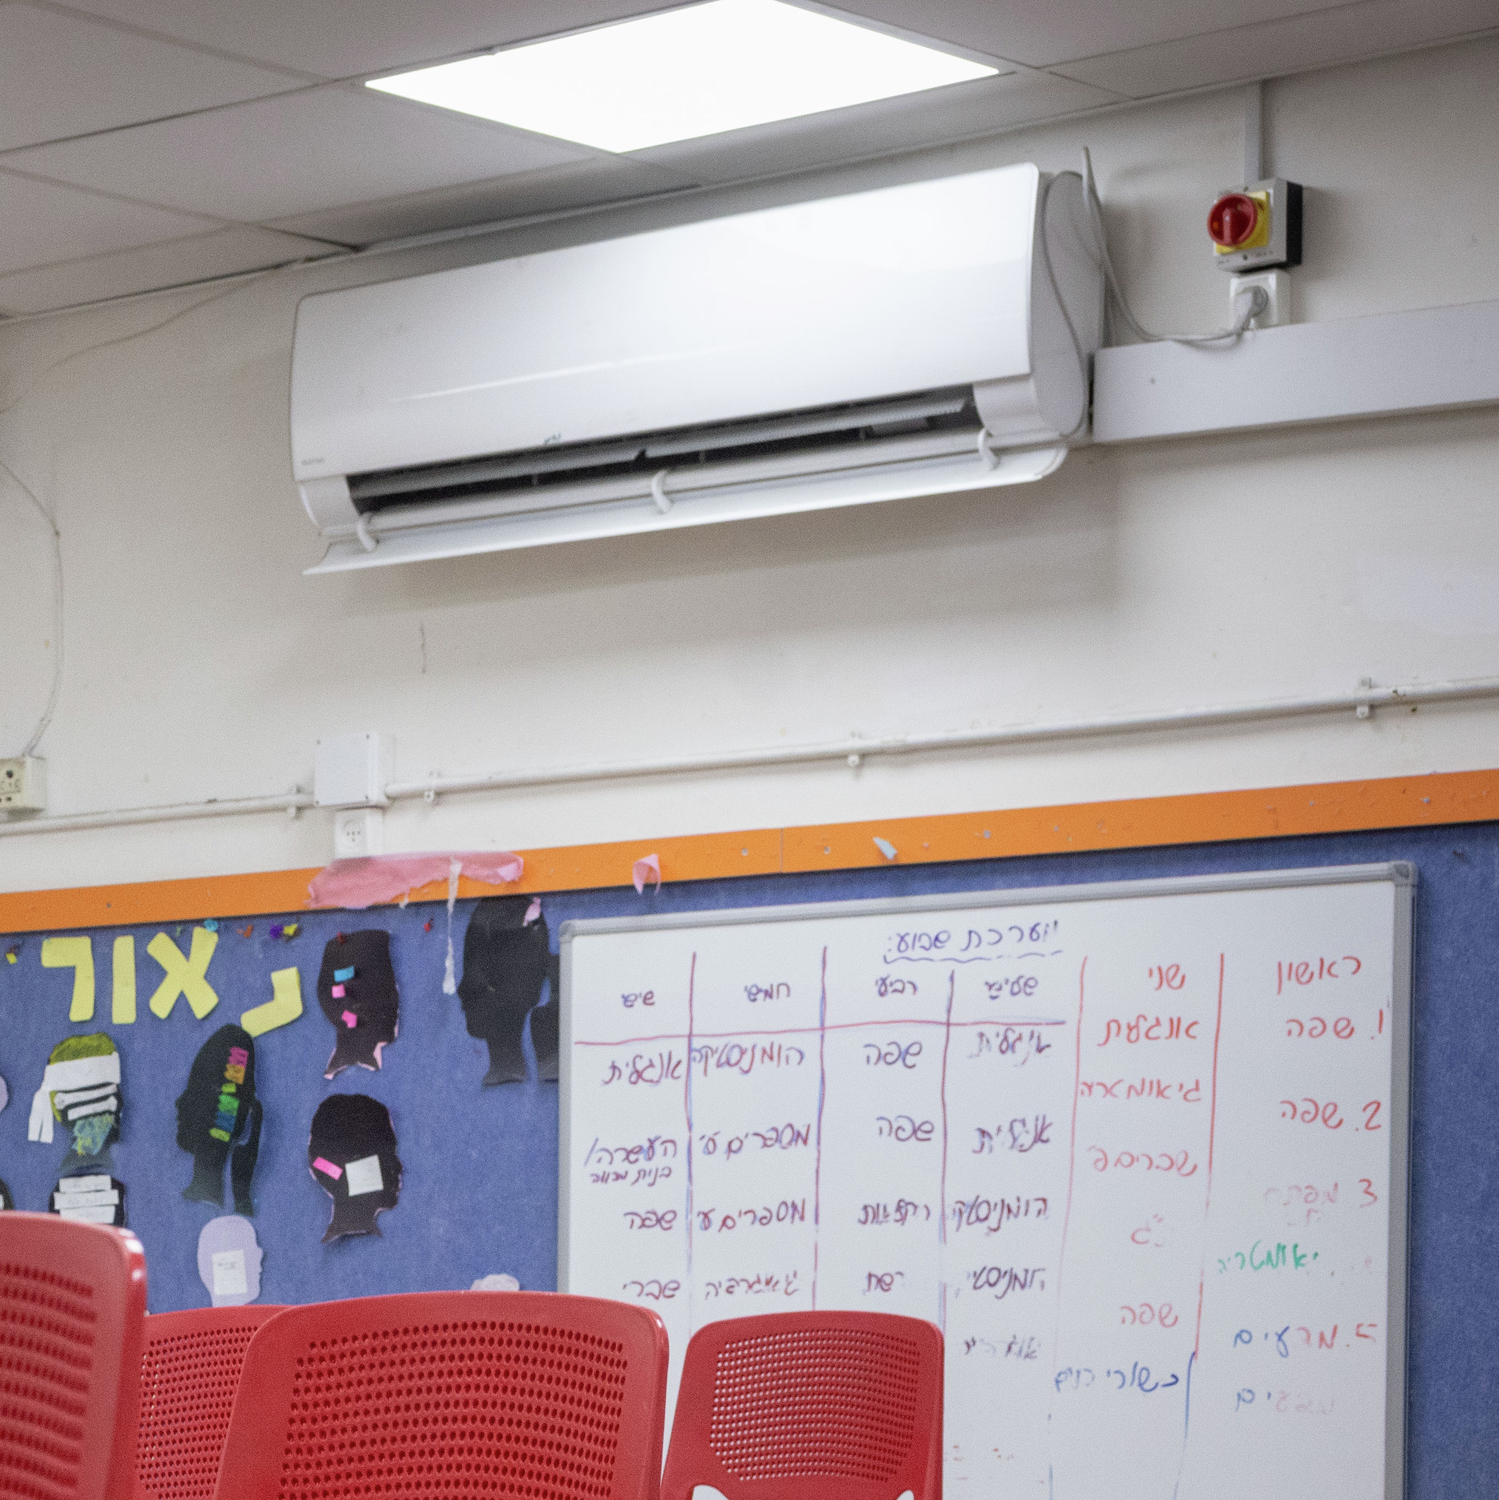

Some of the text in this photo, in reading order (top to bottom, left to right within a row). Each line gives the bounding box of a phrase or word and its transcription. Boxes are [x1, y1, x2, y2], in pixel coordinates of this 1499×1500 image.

[1147, 963, 1187, 991] שני
[1277, 955, 1362, 995] ראשון
[1285, 1016, 1356, 1040] שפה
[862, 1040, 923, 1069] שפה
[1279, 1097, 1344, 1130] שפה
[875, 1114, 935, 1142] שפה
[623, 1208, 678, 1231] שפה
[1120, 1302, 1180, 1328] שפה
